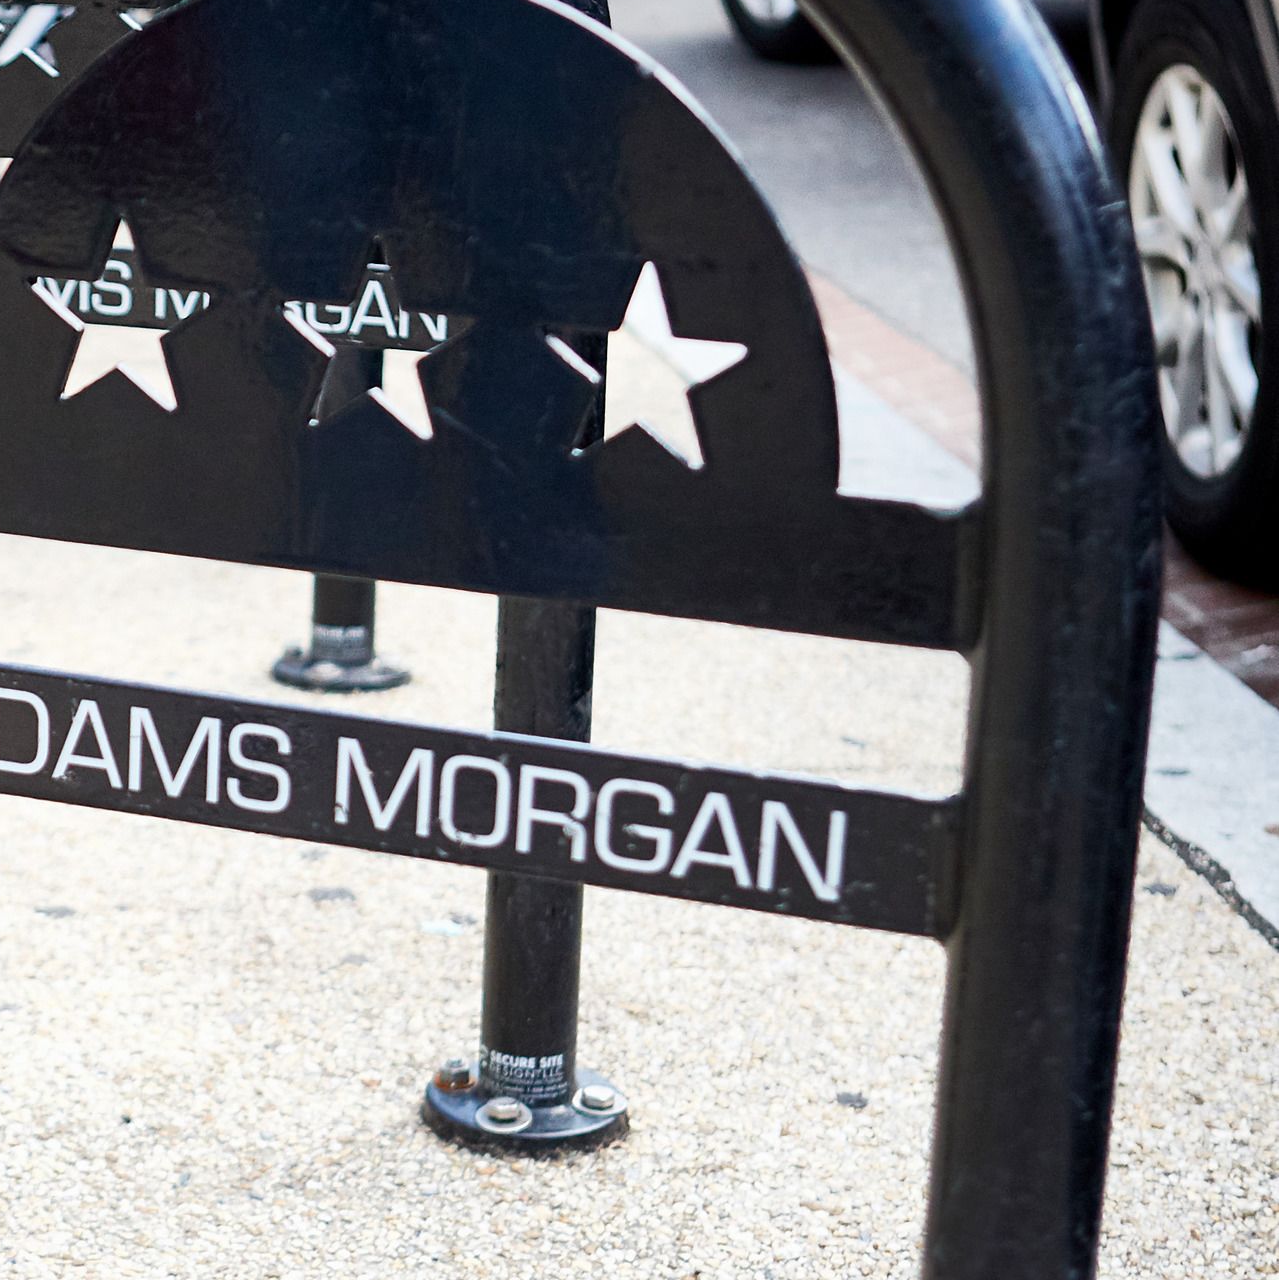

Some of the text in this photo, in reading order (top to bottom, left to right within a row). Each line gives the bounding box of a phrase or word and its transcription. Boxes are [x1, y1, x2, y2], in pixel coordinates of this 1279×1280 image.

[334, 736, 847, 902] MORGAN
[491, 1050, 564, 1069] SECURE SITE
